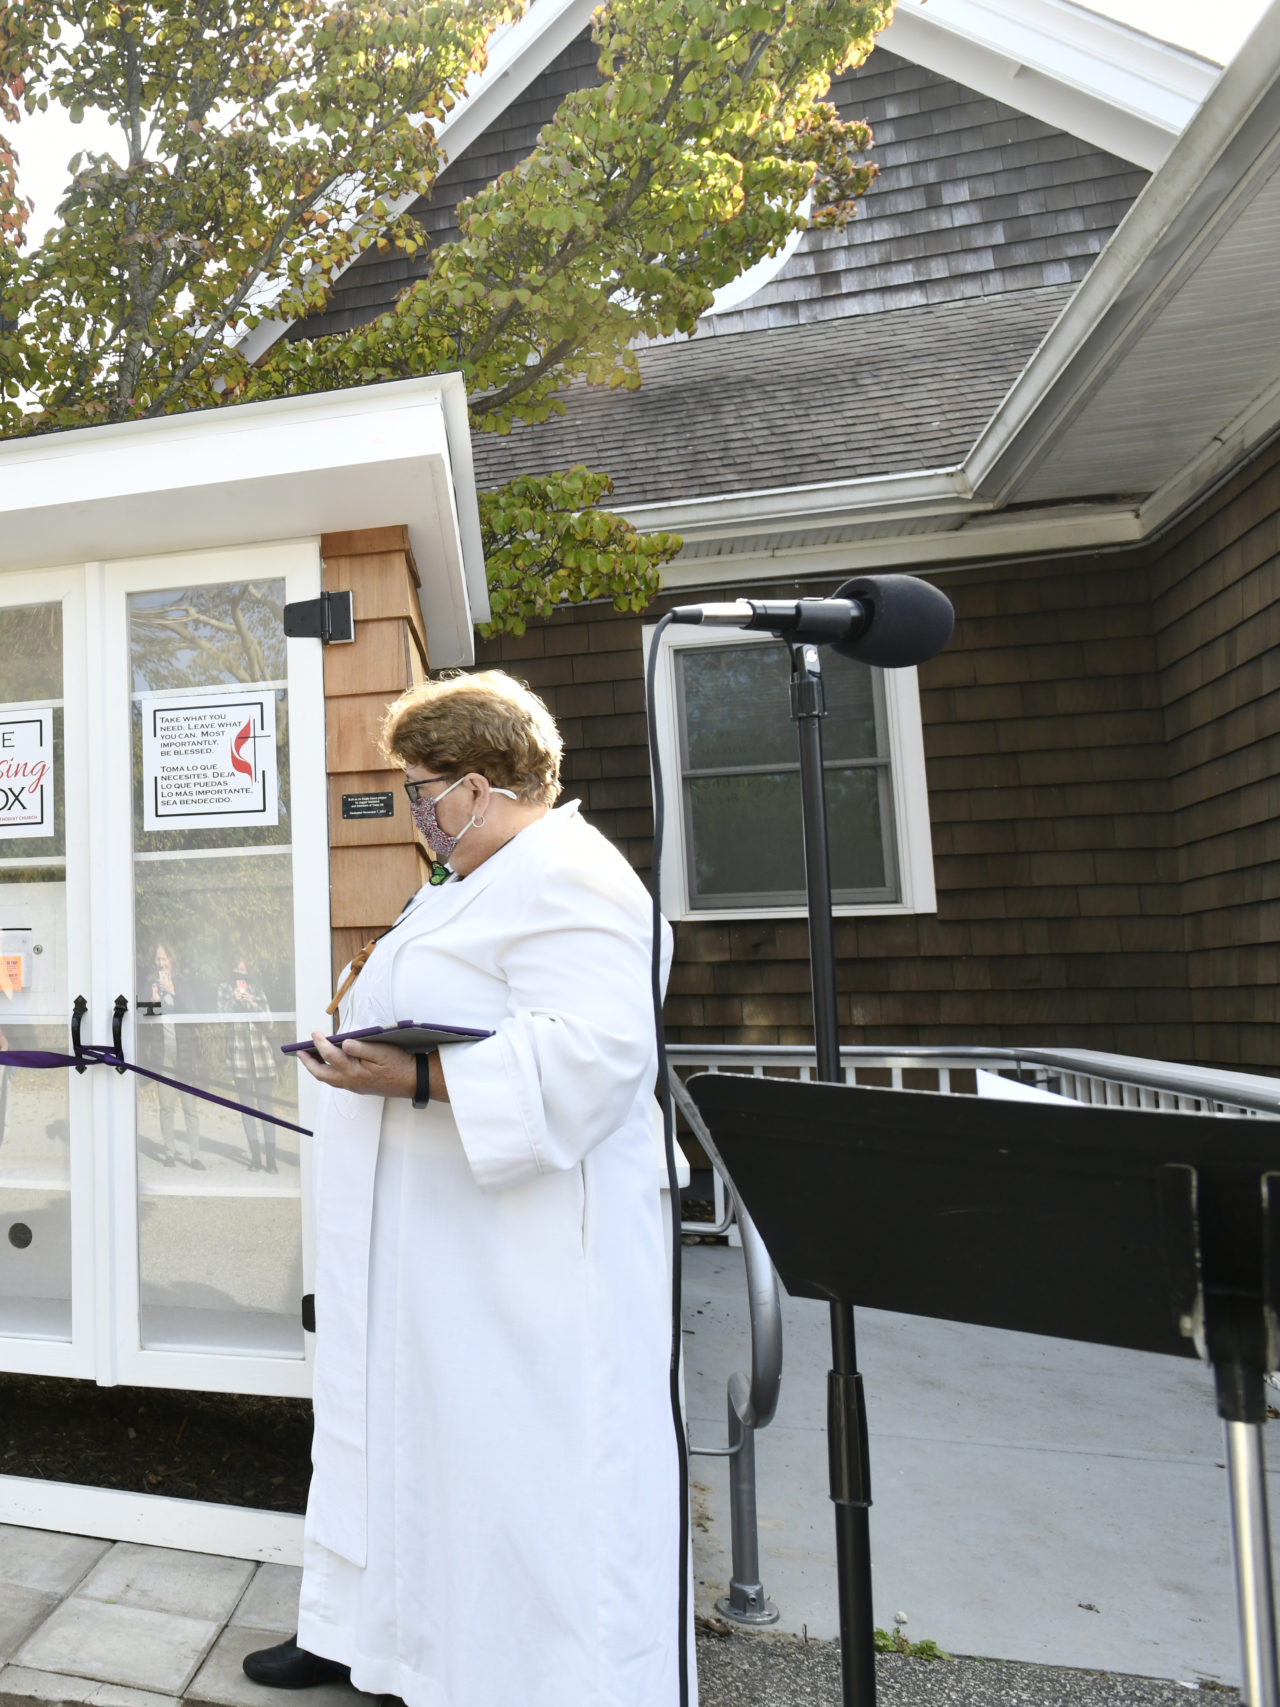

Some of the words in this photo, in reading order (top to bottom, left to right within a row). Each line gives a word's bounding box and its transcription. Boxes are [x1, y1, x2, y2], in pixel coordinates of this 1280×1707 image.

[173, 748, 214, 756] BLESSED.
[175, 789, 194, 797] MÁS
[179, 797, 233, 805] BENDECIDO.
